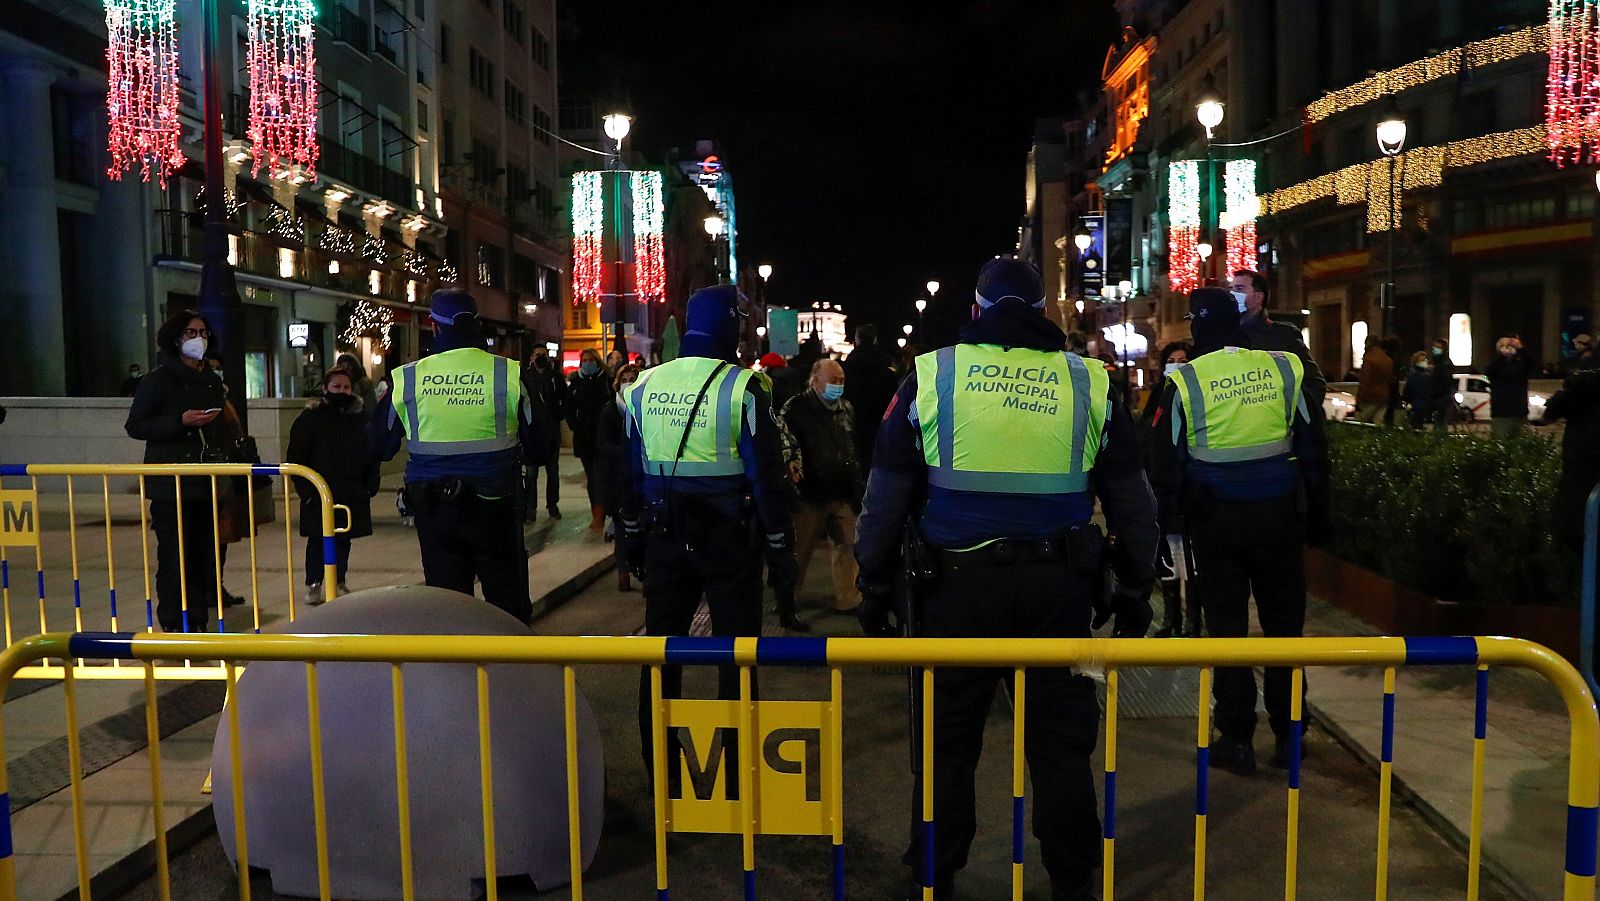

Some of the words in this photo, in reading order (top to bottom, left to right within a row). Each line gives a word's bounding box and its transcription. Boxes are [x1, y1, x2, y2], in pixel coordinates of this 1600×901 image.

[421, 372, 485, 386] POLICÍA
[967, 365, 1060, 386] POLICÍA
[1209, 367, 1273, 392] POLICÍA
[421, 387, 485, 396] MUNICIPAL
[964, 381, 1060, 401] MUNICIPAL
[1213, 381, 1276, 403] MUNICIPAL
[1241, 391, 1278, 406] Madrid
[447, 397, 485, 406] Madrid
[647, 392, 709, 406] POLICA
[1002, 396, 1058, 416] Madrid
[670, 418, 707, 428] Marid
